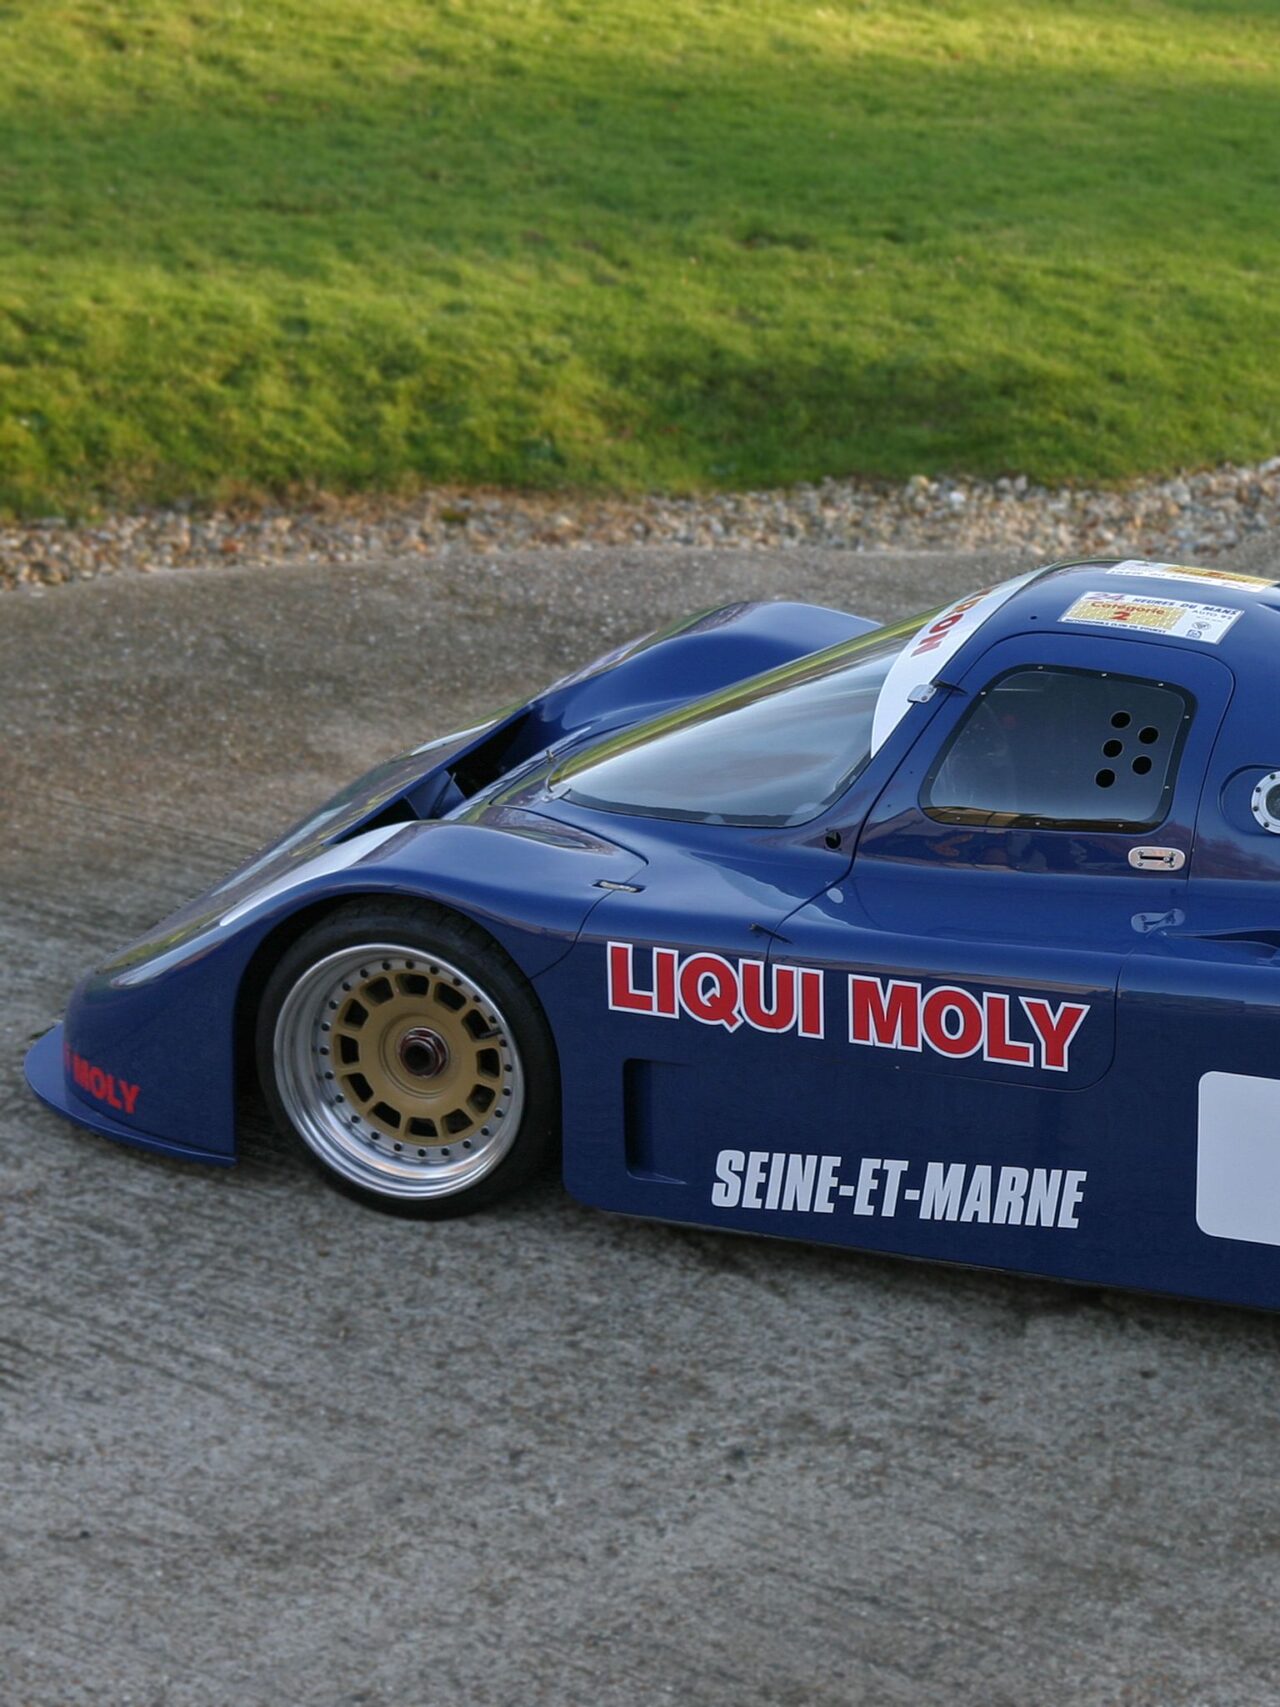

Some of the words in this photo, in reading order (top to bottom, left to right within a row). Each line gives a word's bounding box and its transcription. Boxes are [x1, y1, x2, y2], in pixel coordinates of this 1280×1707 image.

[1110, 611, 1130, 620] 2
[1203, 606, 1237, 615] MANS
[607, 941, 824, 1040] LIQUI
[848, 974, 1090, 1072] MOLY
[73, 1053, 141, 1114] MOLY
[711, 1149, 1087, 1229] SEINE-ET-MARNE
